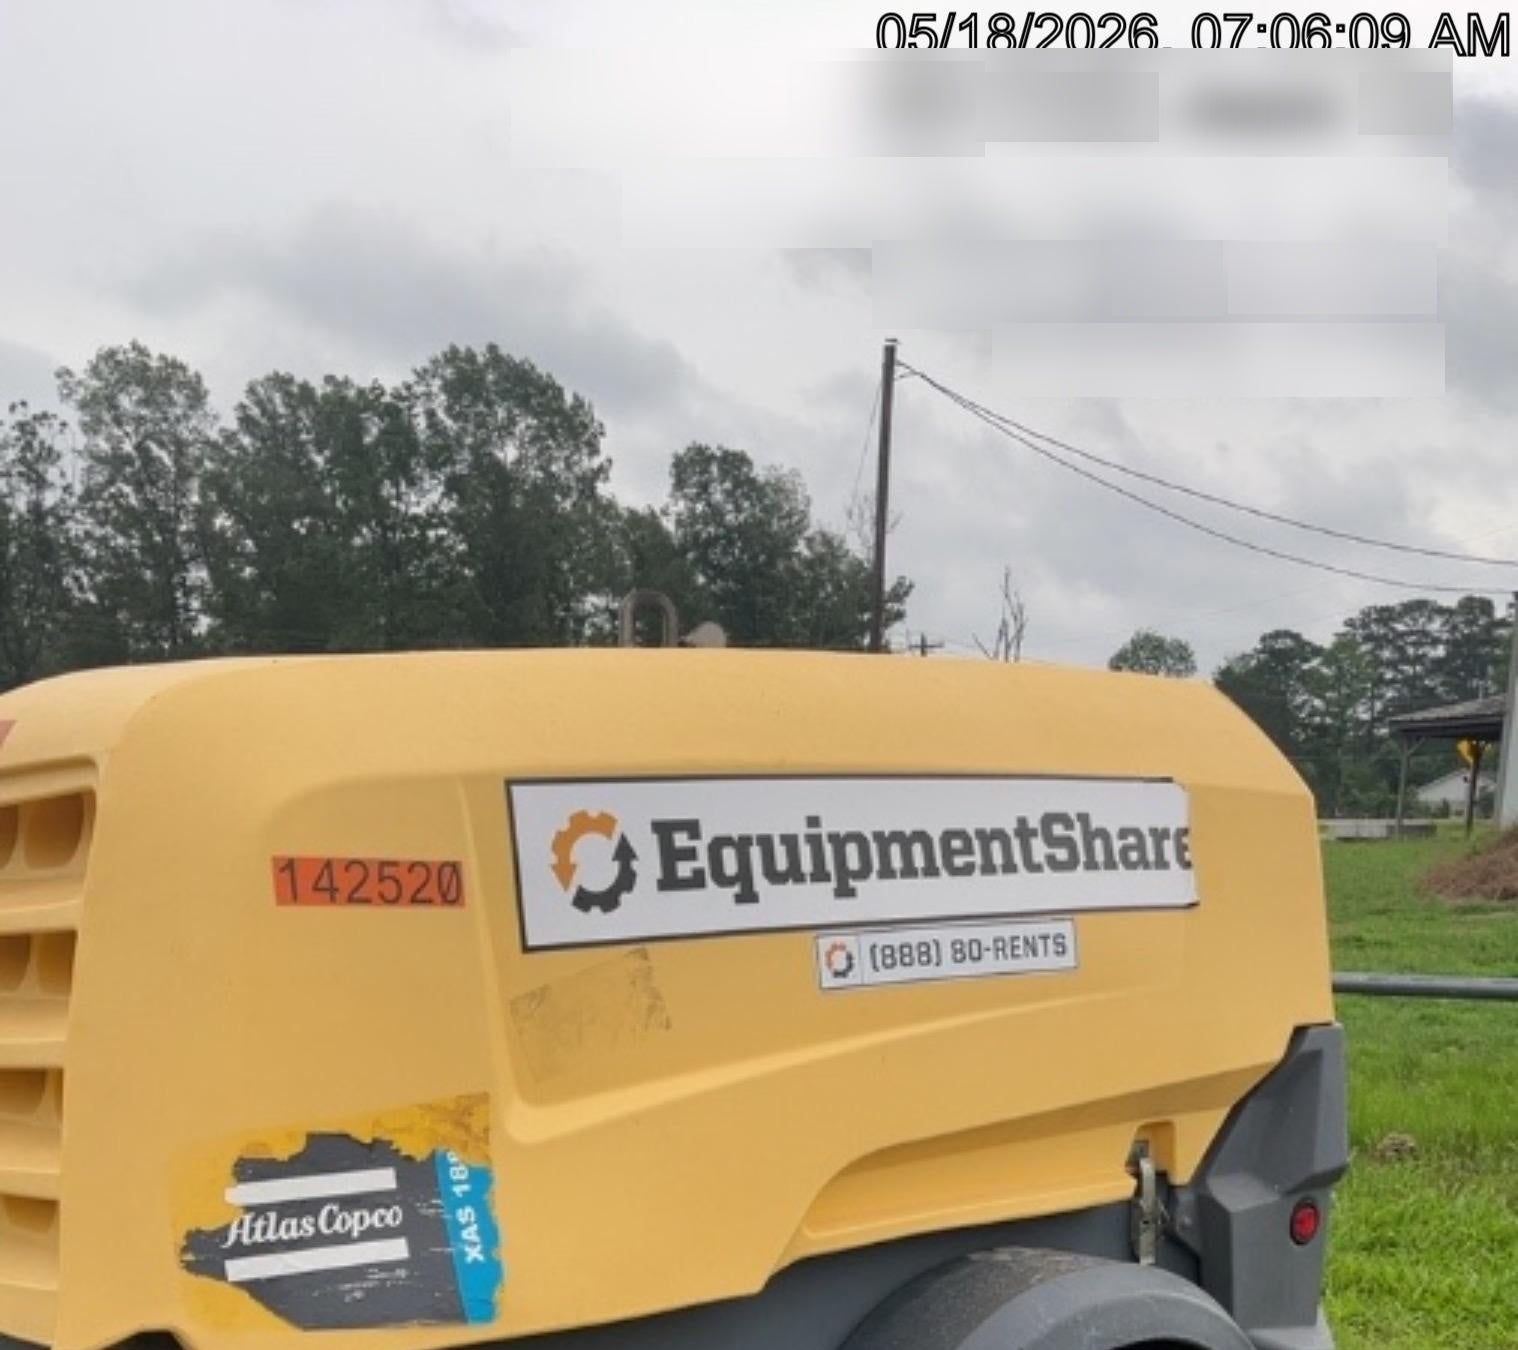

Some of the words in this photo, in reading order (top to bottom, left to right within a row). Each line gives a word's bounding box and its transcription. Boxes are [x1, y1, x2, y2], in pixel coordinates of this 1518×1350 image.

[278, 858, 463, 904] 142520
[869, 938, 943, 973] (888)
[950, 933, 1067, 964] 80-RENTS
[455, 1205, 485, 1264] XAS
